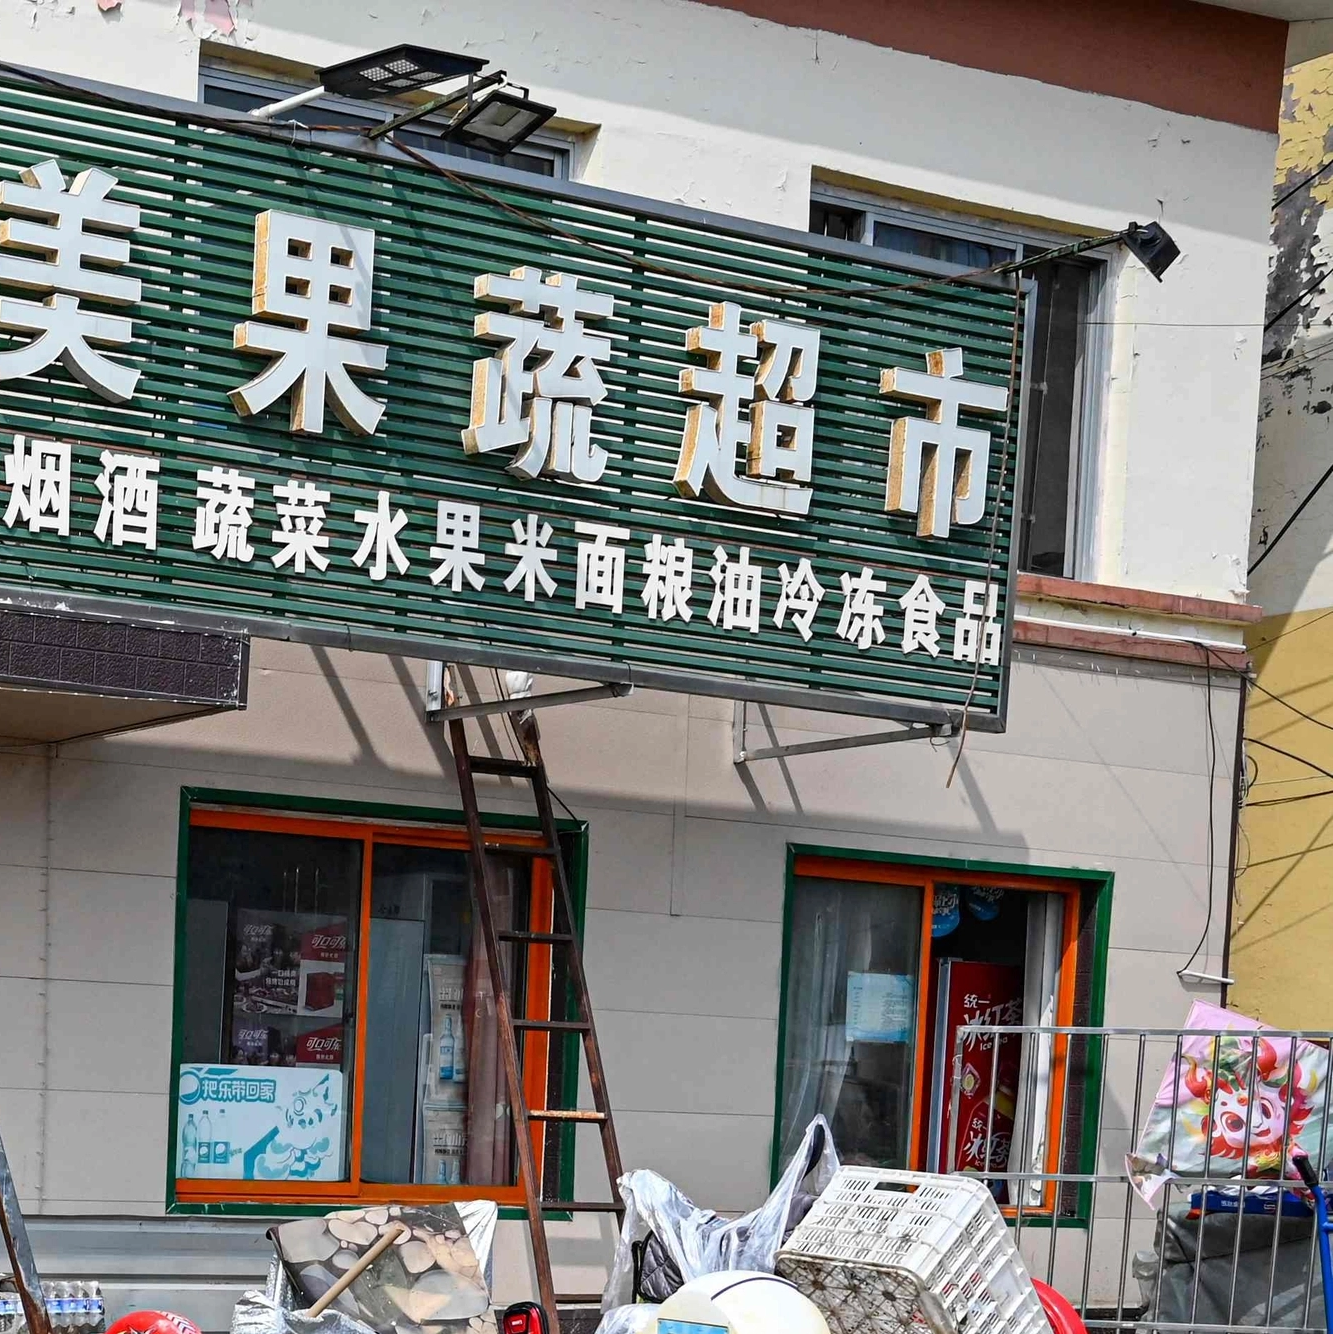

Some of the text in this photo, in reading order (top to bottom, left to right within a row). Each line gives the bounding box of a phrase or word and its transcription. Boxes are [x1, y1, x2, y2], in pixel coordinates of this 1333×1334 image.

[963, 993, 990, 1008] 统一
[202, 1079, 277, 1102] 把乐带回家
